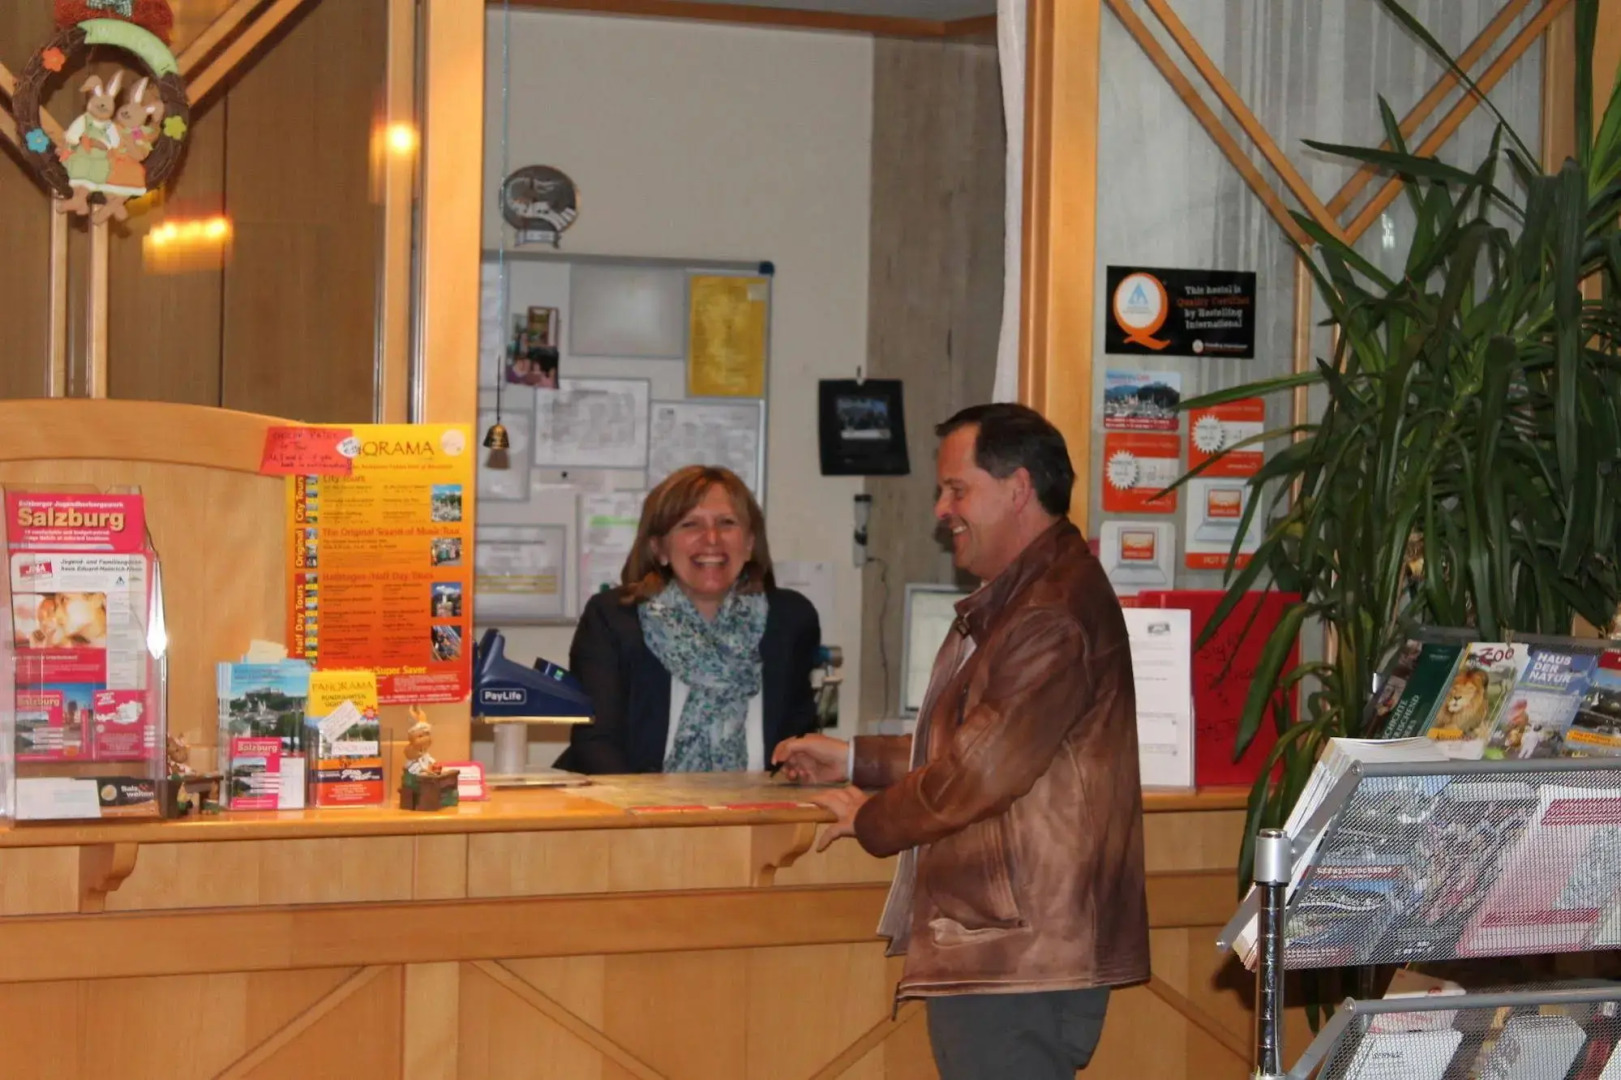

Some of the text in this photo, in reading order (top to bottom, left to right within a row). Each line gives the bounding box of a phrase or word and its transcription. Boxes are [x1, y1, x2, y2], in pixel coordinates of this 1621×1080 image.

[1184, 284, 1242, 295] This hostel is
[1177, 298, 1209, 308] Quality
[1184, 307, 1243, 320] by Hostelling
[1185, 320, 1243, 330] International
[295, 477, 304, 521] City Tours
[18, 507, 124, 532] Salzburg
[323, 528, 339, 536] The
[341, 527, 375, 538] Original
[295, 529, 304, 567] Original
[392, 571, 409, 581] Day
[295, 584, 304, 655] Half Day Tours
[1537, 652, 1572, 666] HAUS
[403, 665, 428, 675] Saver
[1533, 662, 1559, 673] DER
[1529, 671, 1572, 683] NATUR
[484, 691, 522, 703] PayLife
[238, 743, 278, 752] Salzburg
